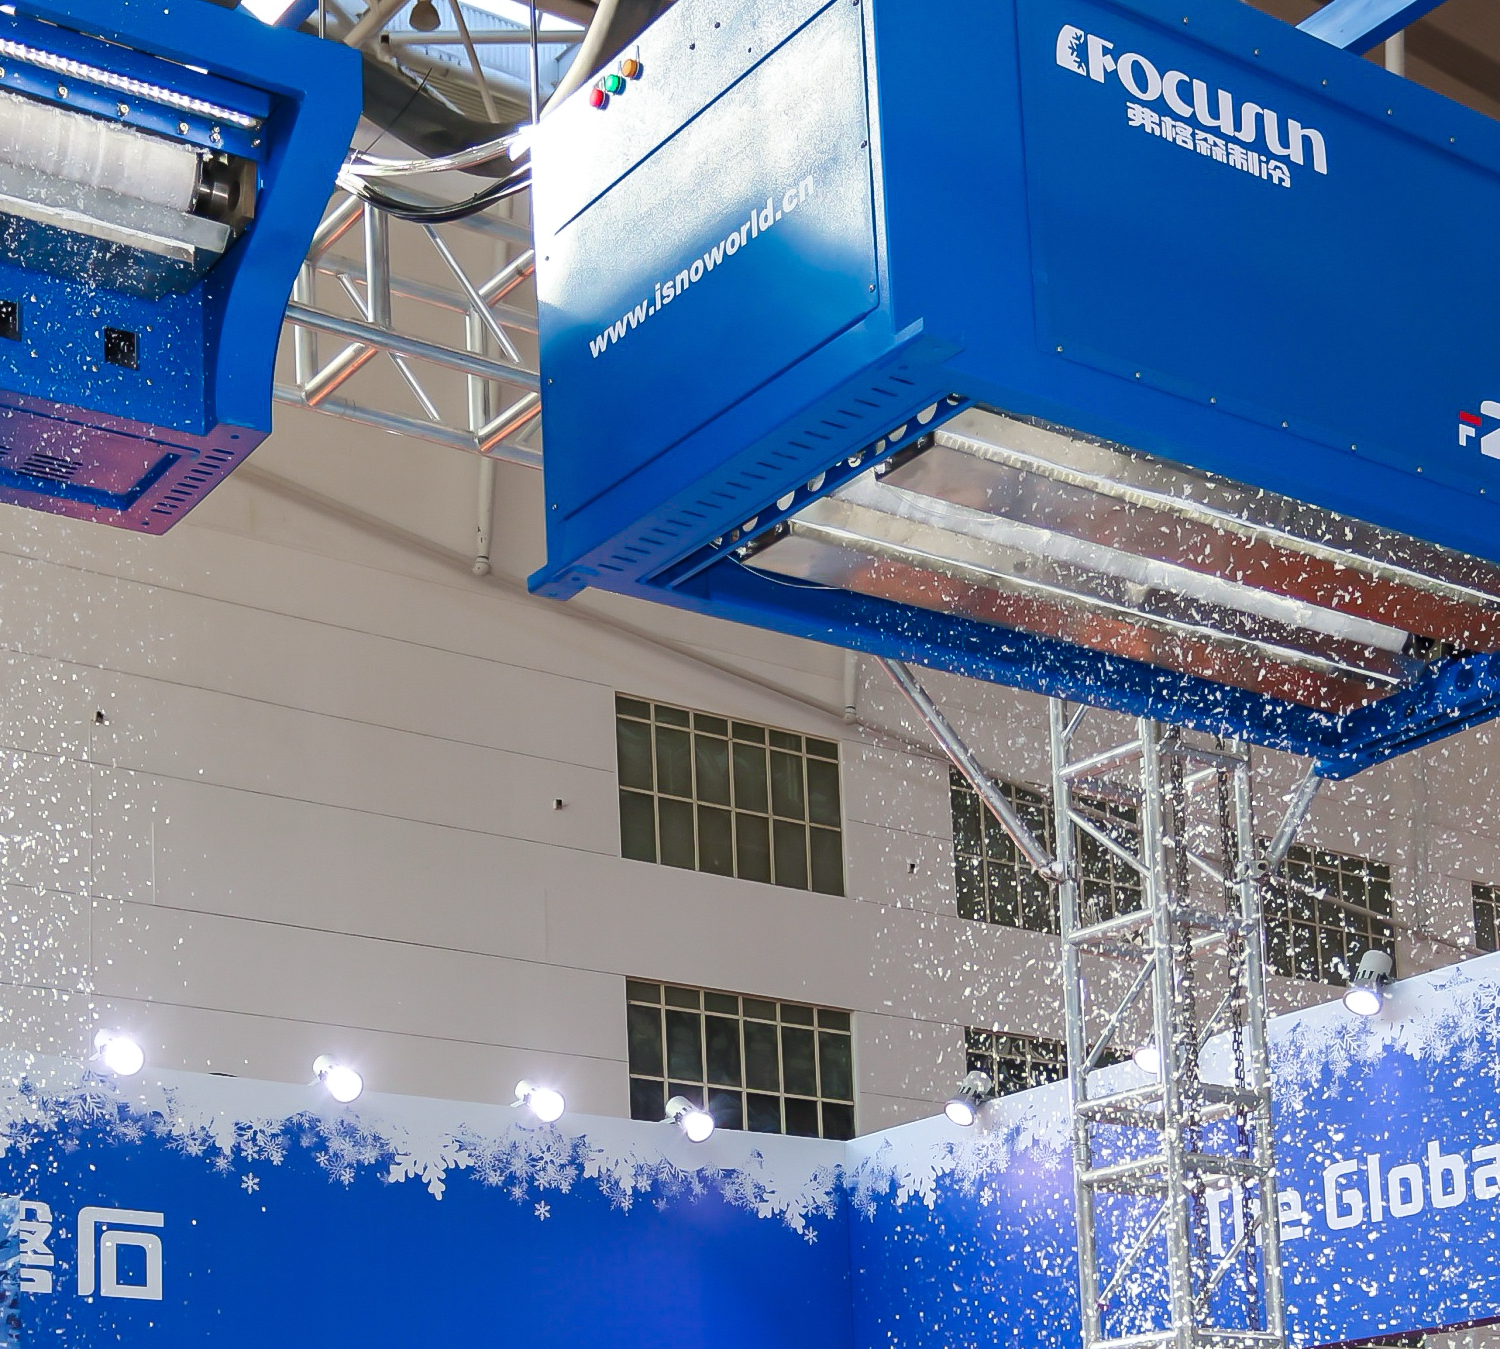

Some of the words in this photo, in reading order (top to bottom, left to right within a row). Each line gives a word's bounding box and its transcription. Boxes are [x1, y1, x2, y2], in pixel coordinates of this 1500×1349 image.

[1127, 101, 1291, 188] 弗格森制冷
[588, 173, 815, 359] www.isnoworld.cn
